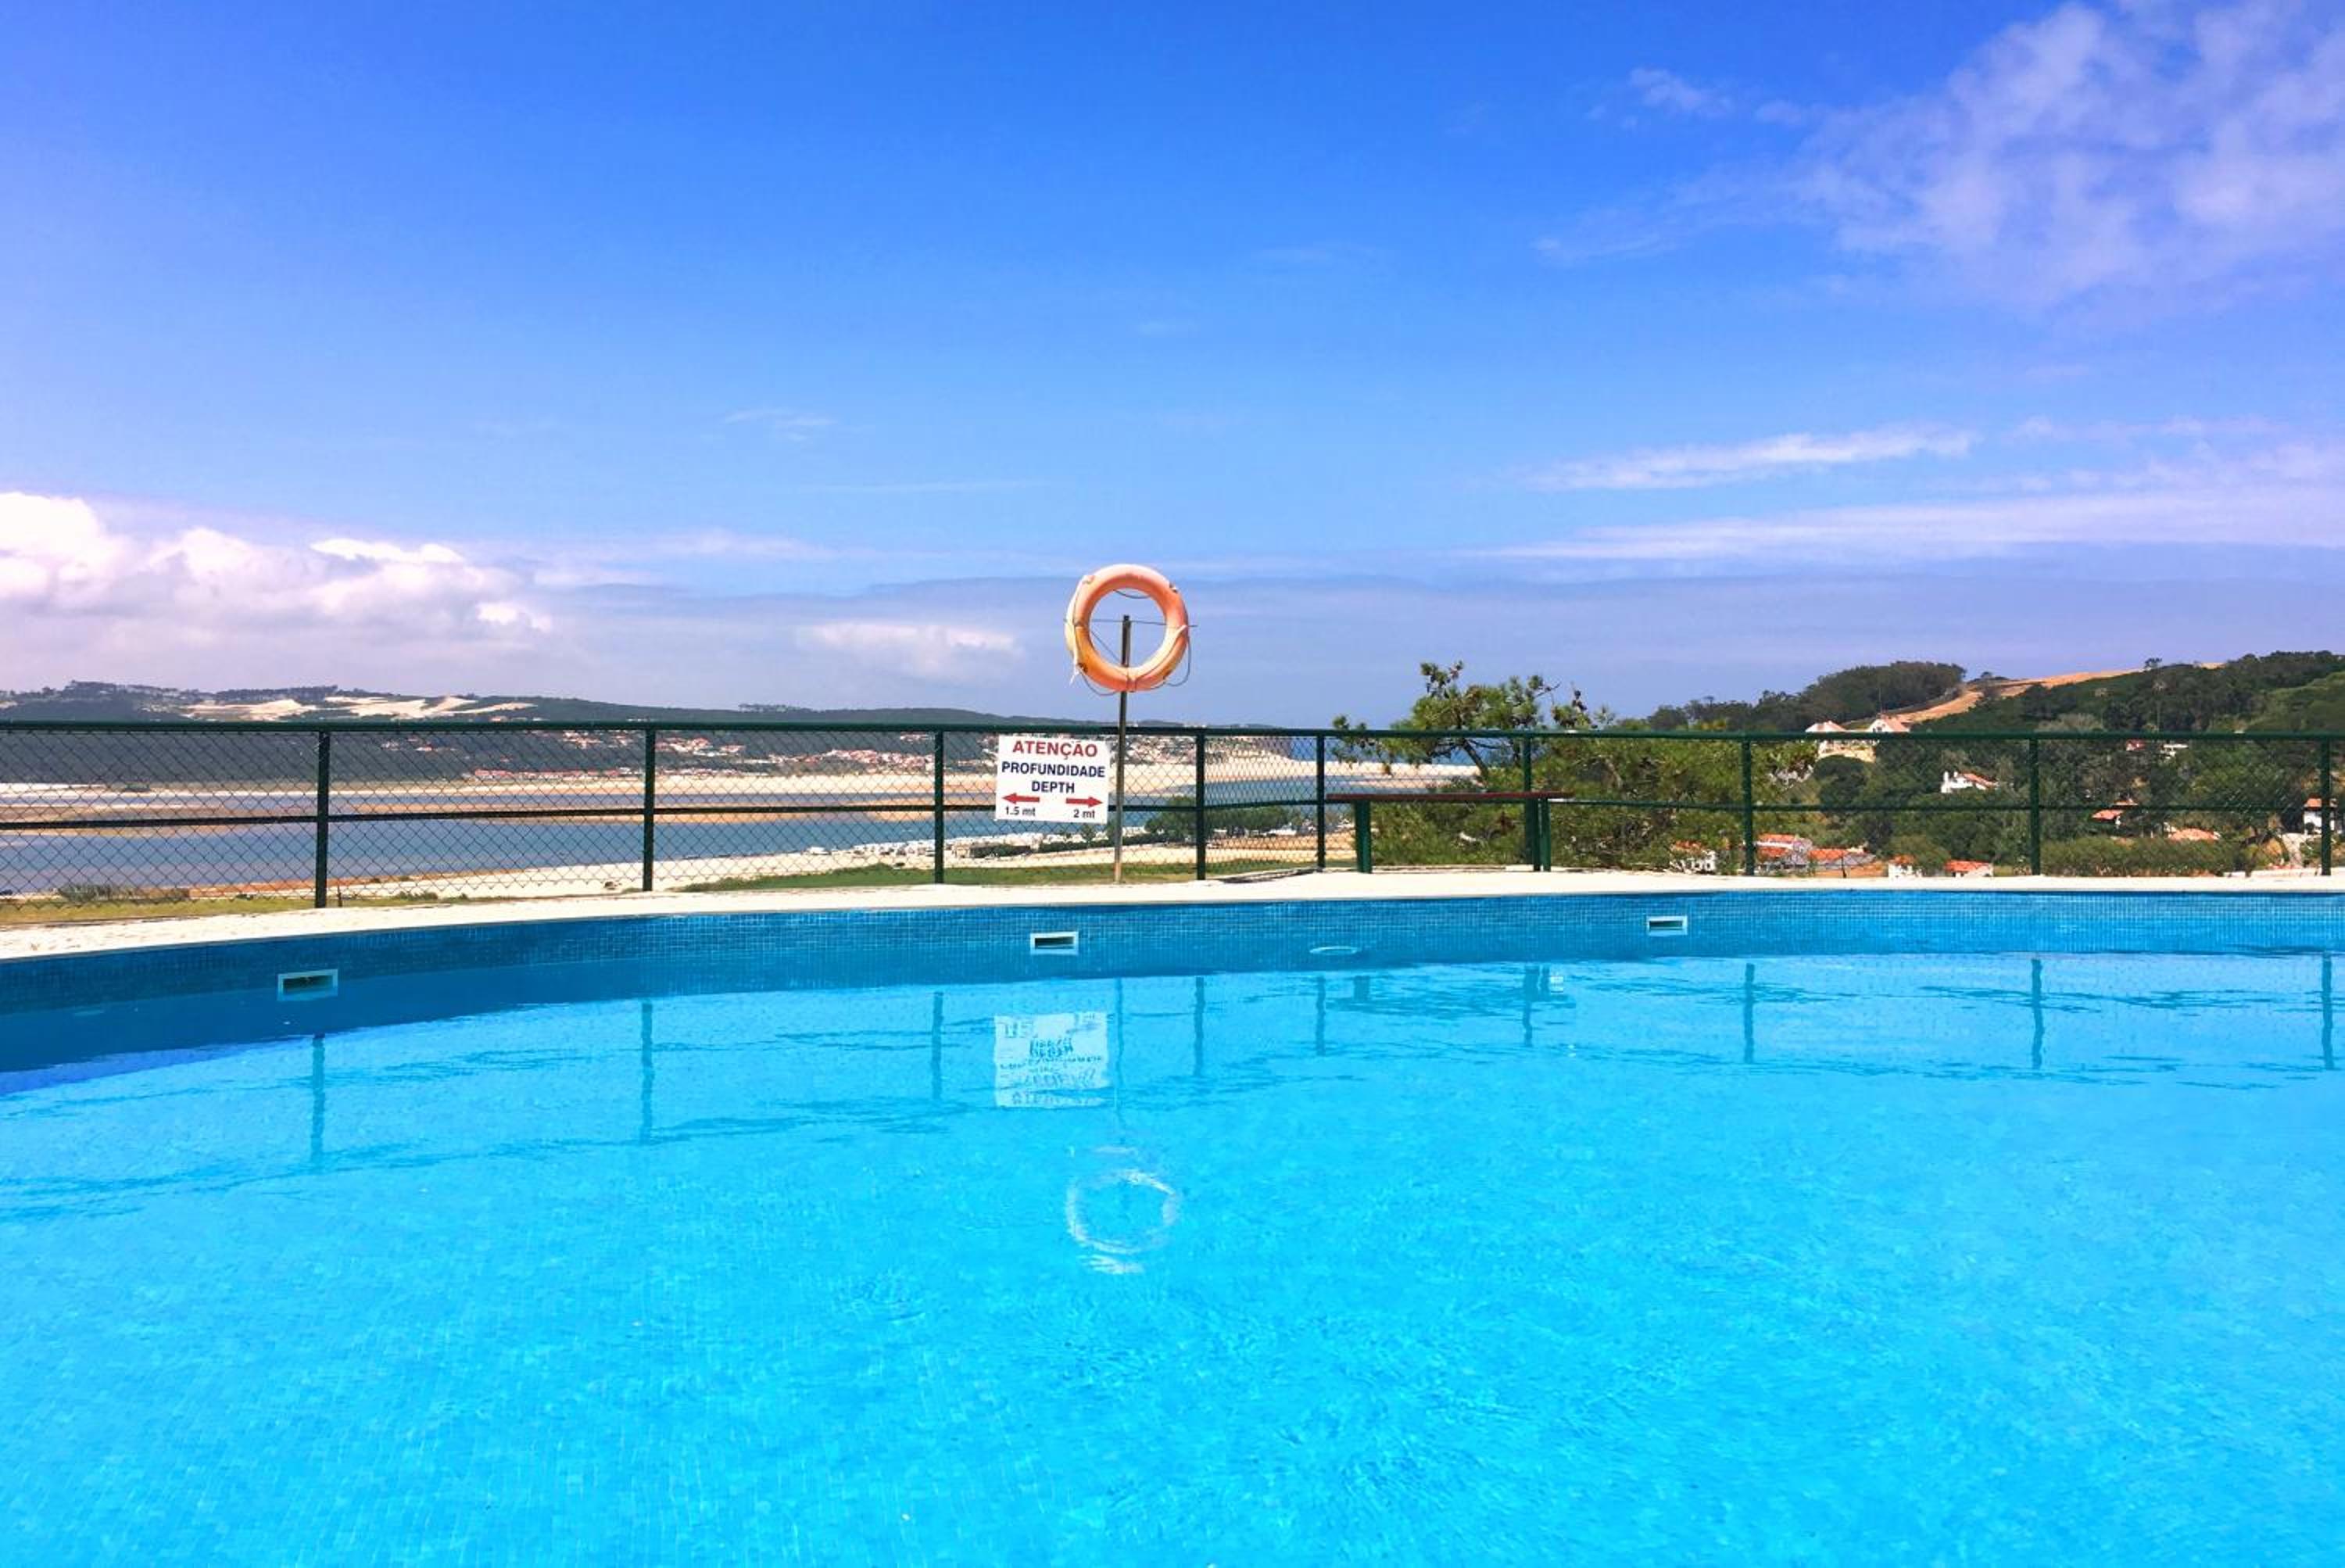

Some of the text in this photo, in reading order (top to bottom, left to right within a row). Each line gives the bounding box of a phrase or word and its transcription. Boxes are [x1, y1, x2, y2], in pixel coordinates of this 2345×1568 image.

[1012, 739, 1097, 760] ATENÇÃO
[1001, 761, 1105, 777] PROFUNDIDADE
[1031, 781, 1075, 793] DEPTH
[1005, 807, 1036, 816] 1.5 mt
[1073, 809, 1095, 818] 2 mt
